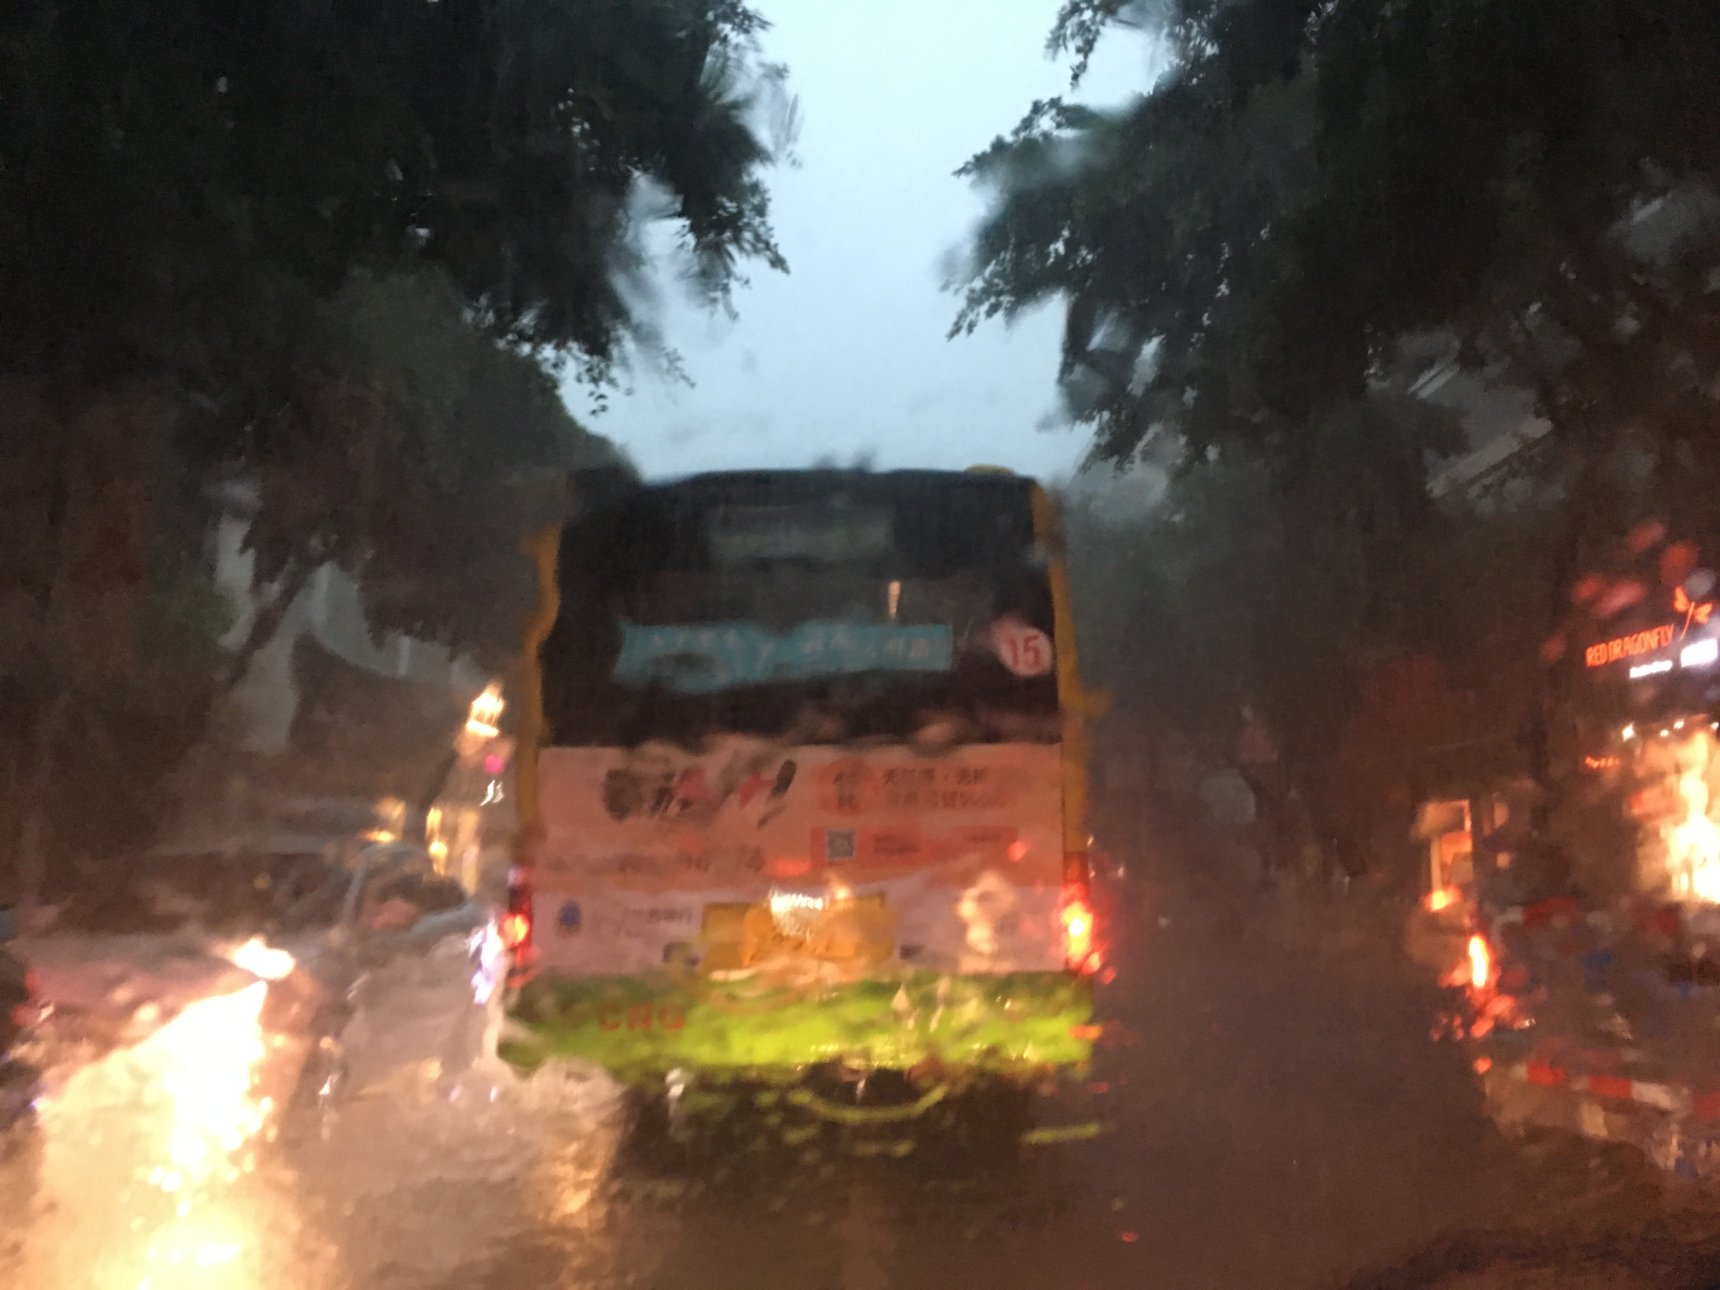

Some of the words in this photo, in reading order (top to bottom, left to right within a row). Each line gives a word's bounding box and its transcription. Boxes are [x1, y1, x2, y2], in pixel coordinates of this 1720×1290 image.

[1008, 634, 1041, 671] 15
[1586, 643, 1607, 667] RED
[1608, 624, 1674, 662] DRAGONFLY
